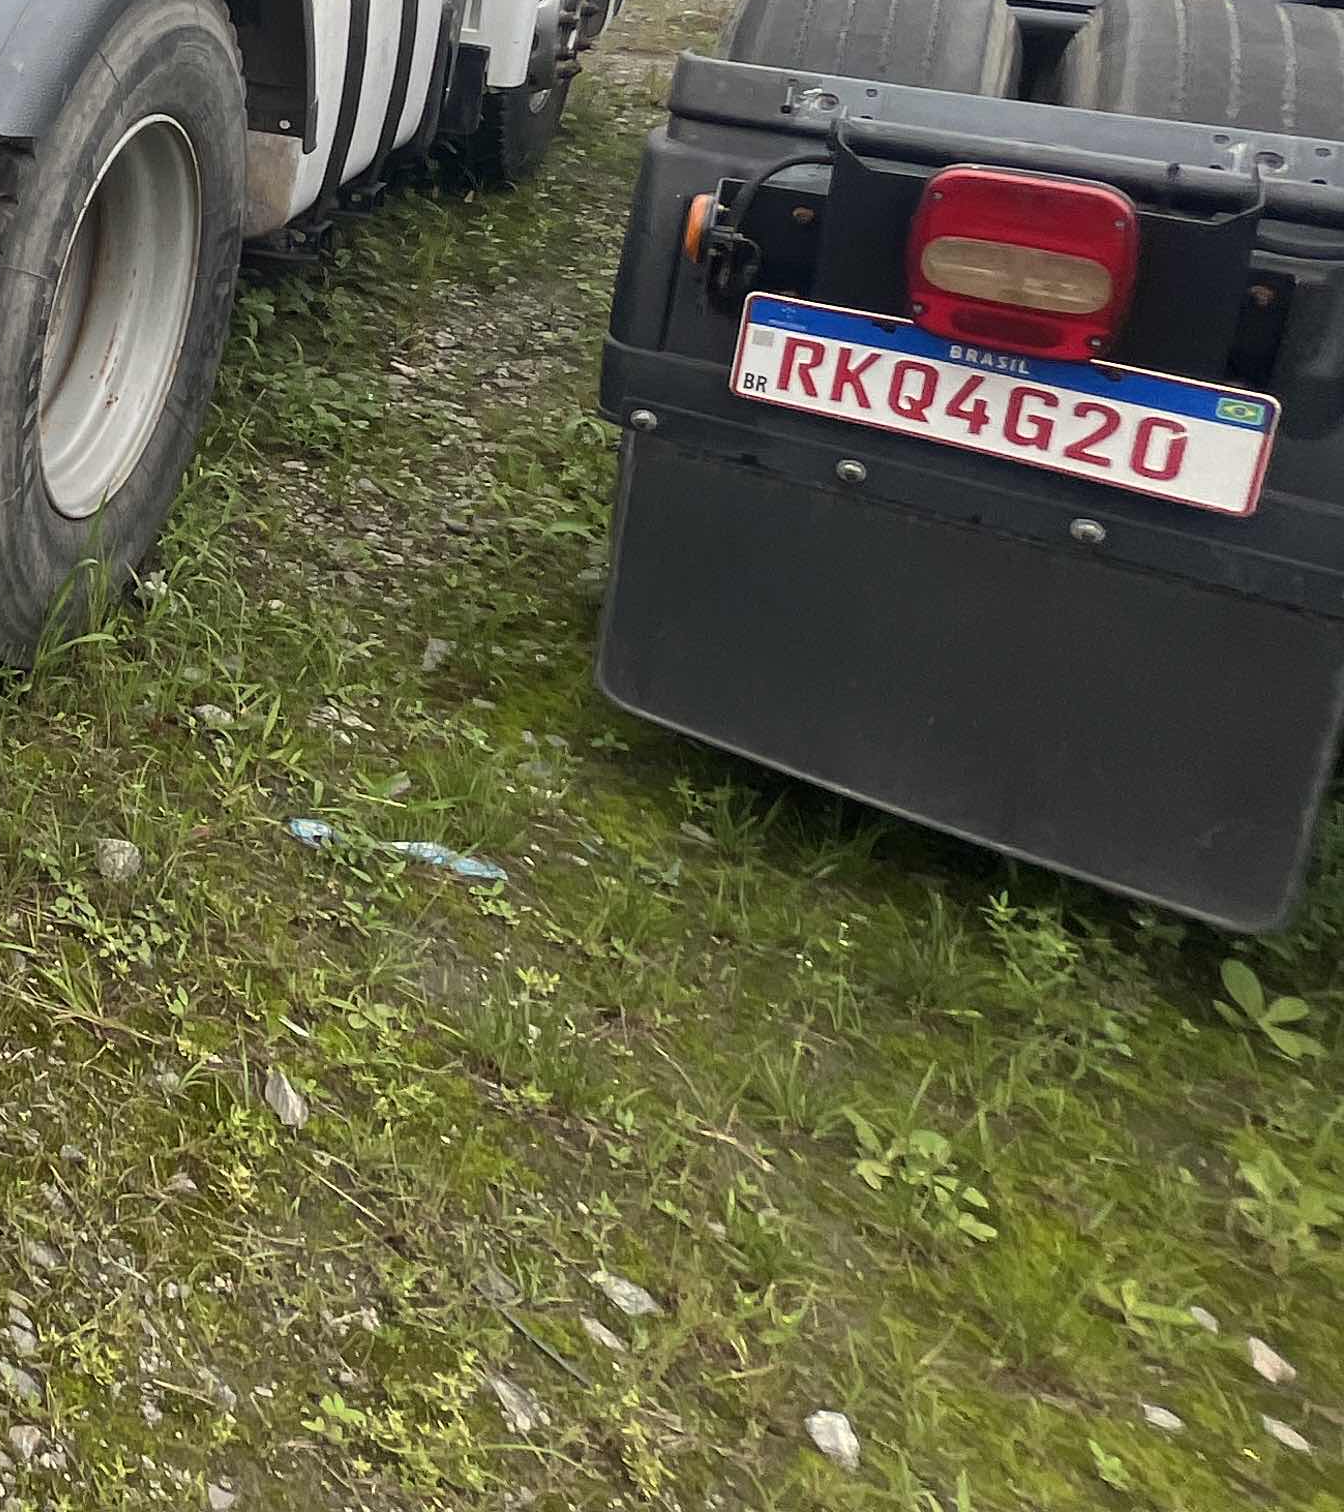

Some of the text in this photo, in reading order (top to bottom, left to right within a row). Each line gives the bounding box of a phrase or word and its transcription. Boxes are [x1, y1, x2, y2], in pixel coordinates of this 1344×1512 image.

[949, 344, 1031, 374] BRASIL
[743, 372, 768, 393] BR
[777, 336, 1189, 482] RKQ4G20
